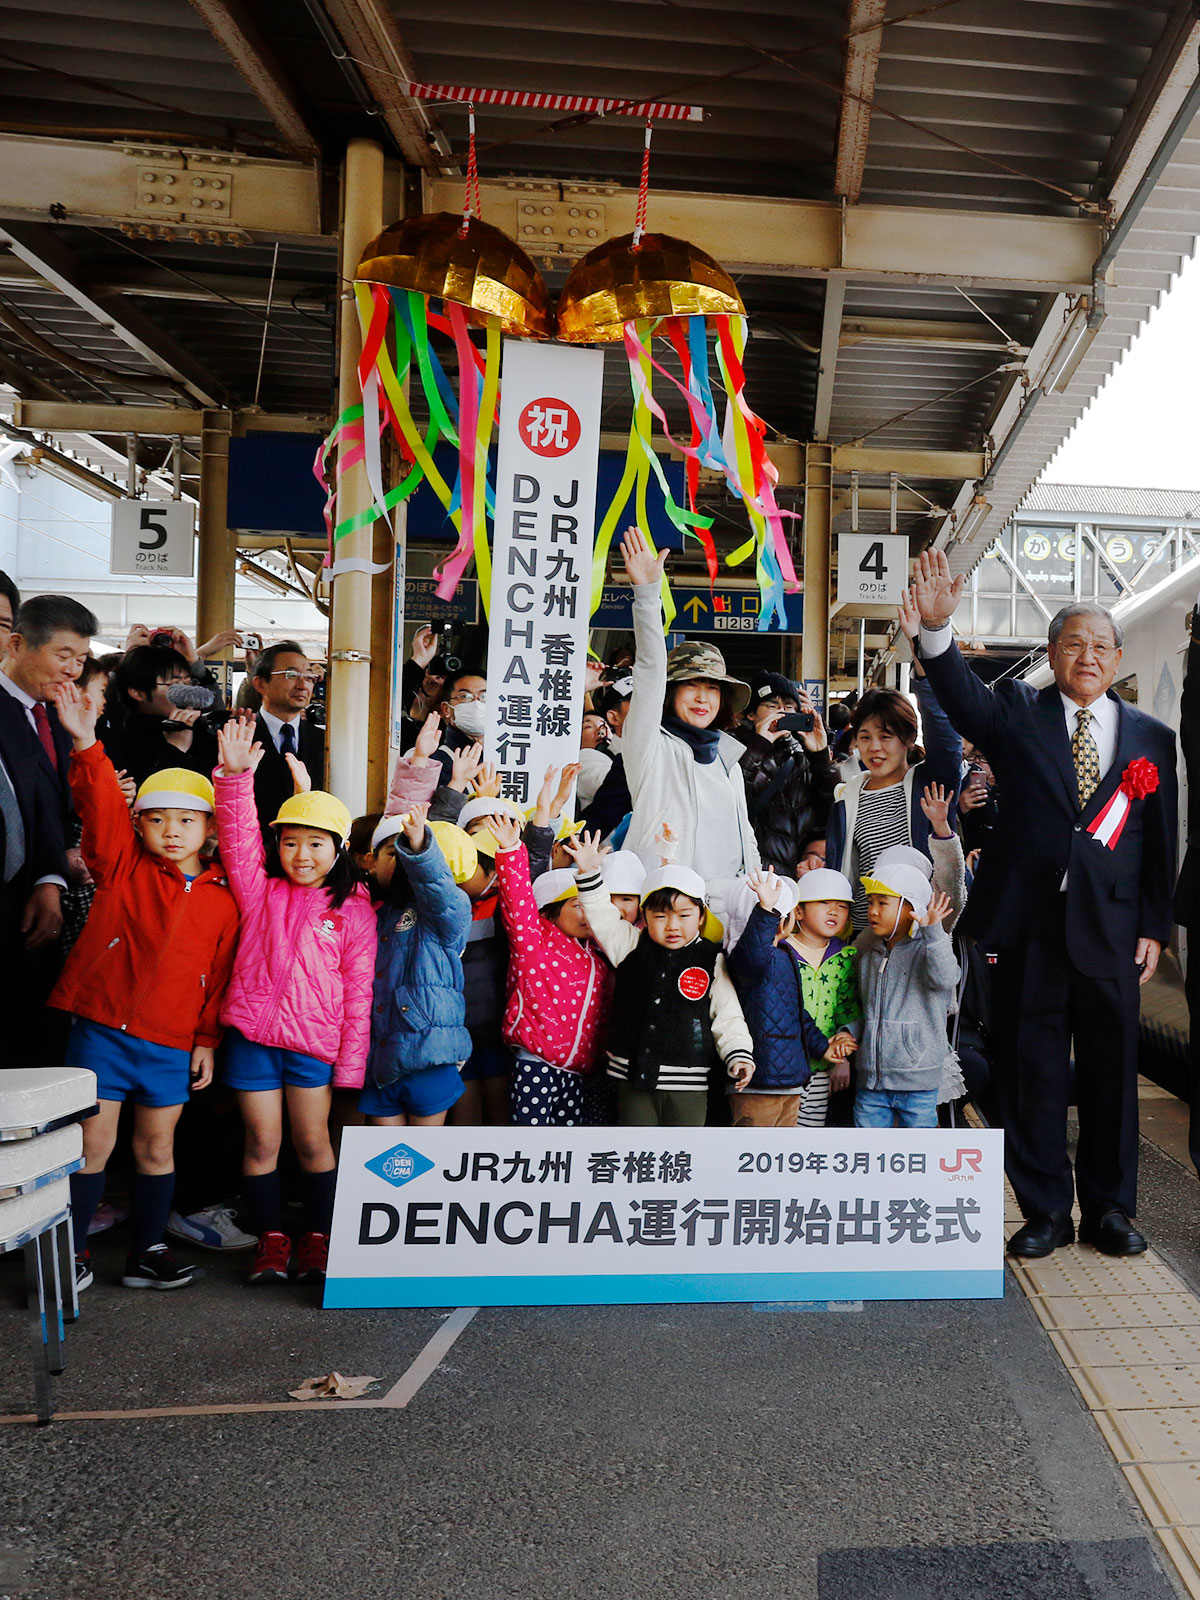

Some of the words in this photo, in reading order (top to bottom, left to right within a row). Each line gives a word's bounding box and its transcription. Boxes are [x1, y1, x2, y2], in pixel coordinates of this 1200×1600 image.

[526, 405, 569, 449] 祝
[138, 508, 168, 550] 5
[135, 553, 169, 563] のりば
[543, 480, 580, 618] JR九州
[859, 542, 888, 580] 4
[859, 583, 888, 592] のりば
[536, 633, 575, 737] 香椎線
[810, 685, 820, 699] 4
[393, 1167, 412, 1176] CHA
[394, 1159, 412, 1167] DEN
[442, 1150, 573, 1184] JR九州
[587, 1150, 692, 1183] 香椎線
[738, 1152, 927, 1175] 2019年3月16日
[939, 1148, 983, 1173] JR
[358, 1198, 982, 1246] DENCHA運行開始出発式
